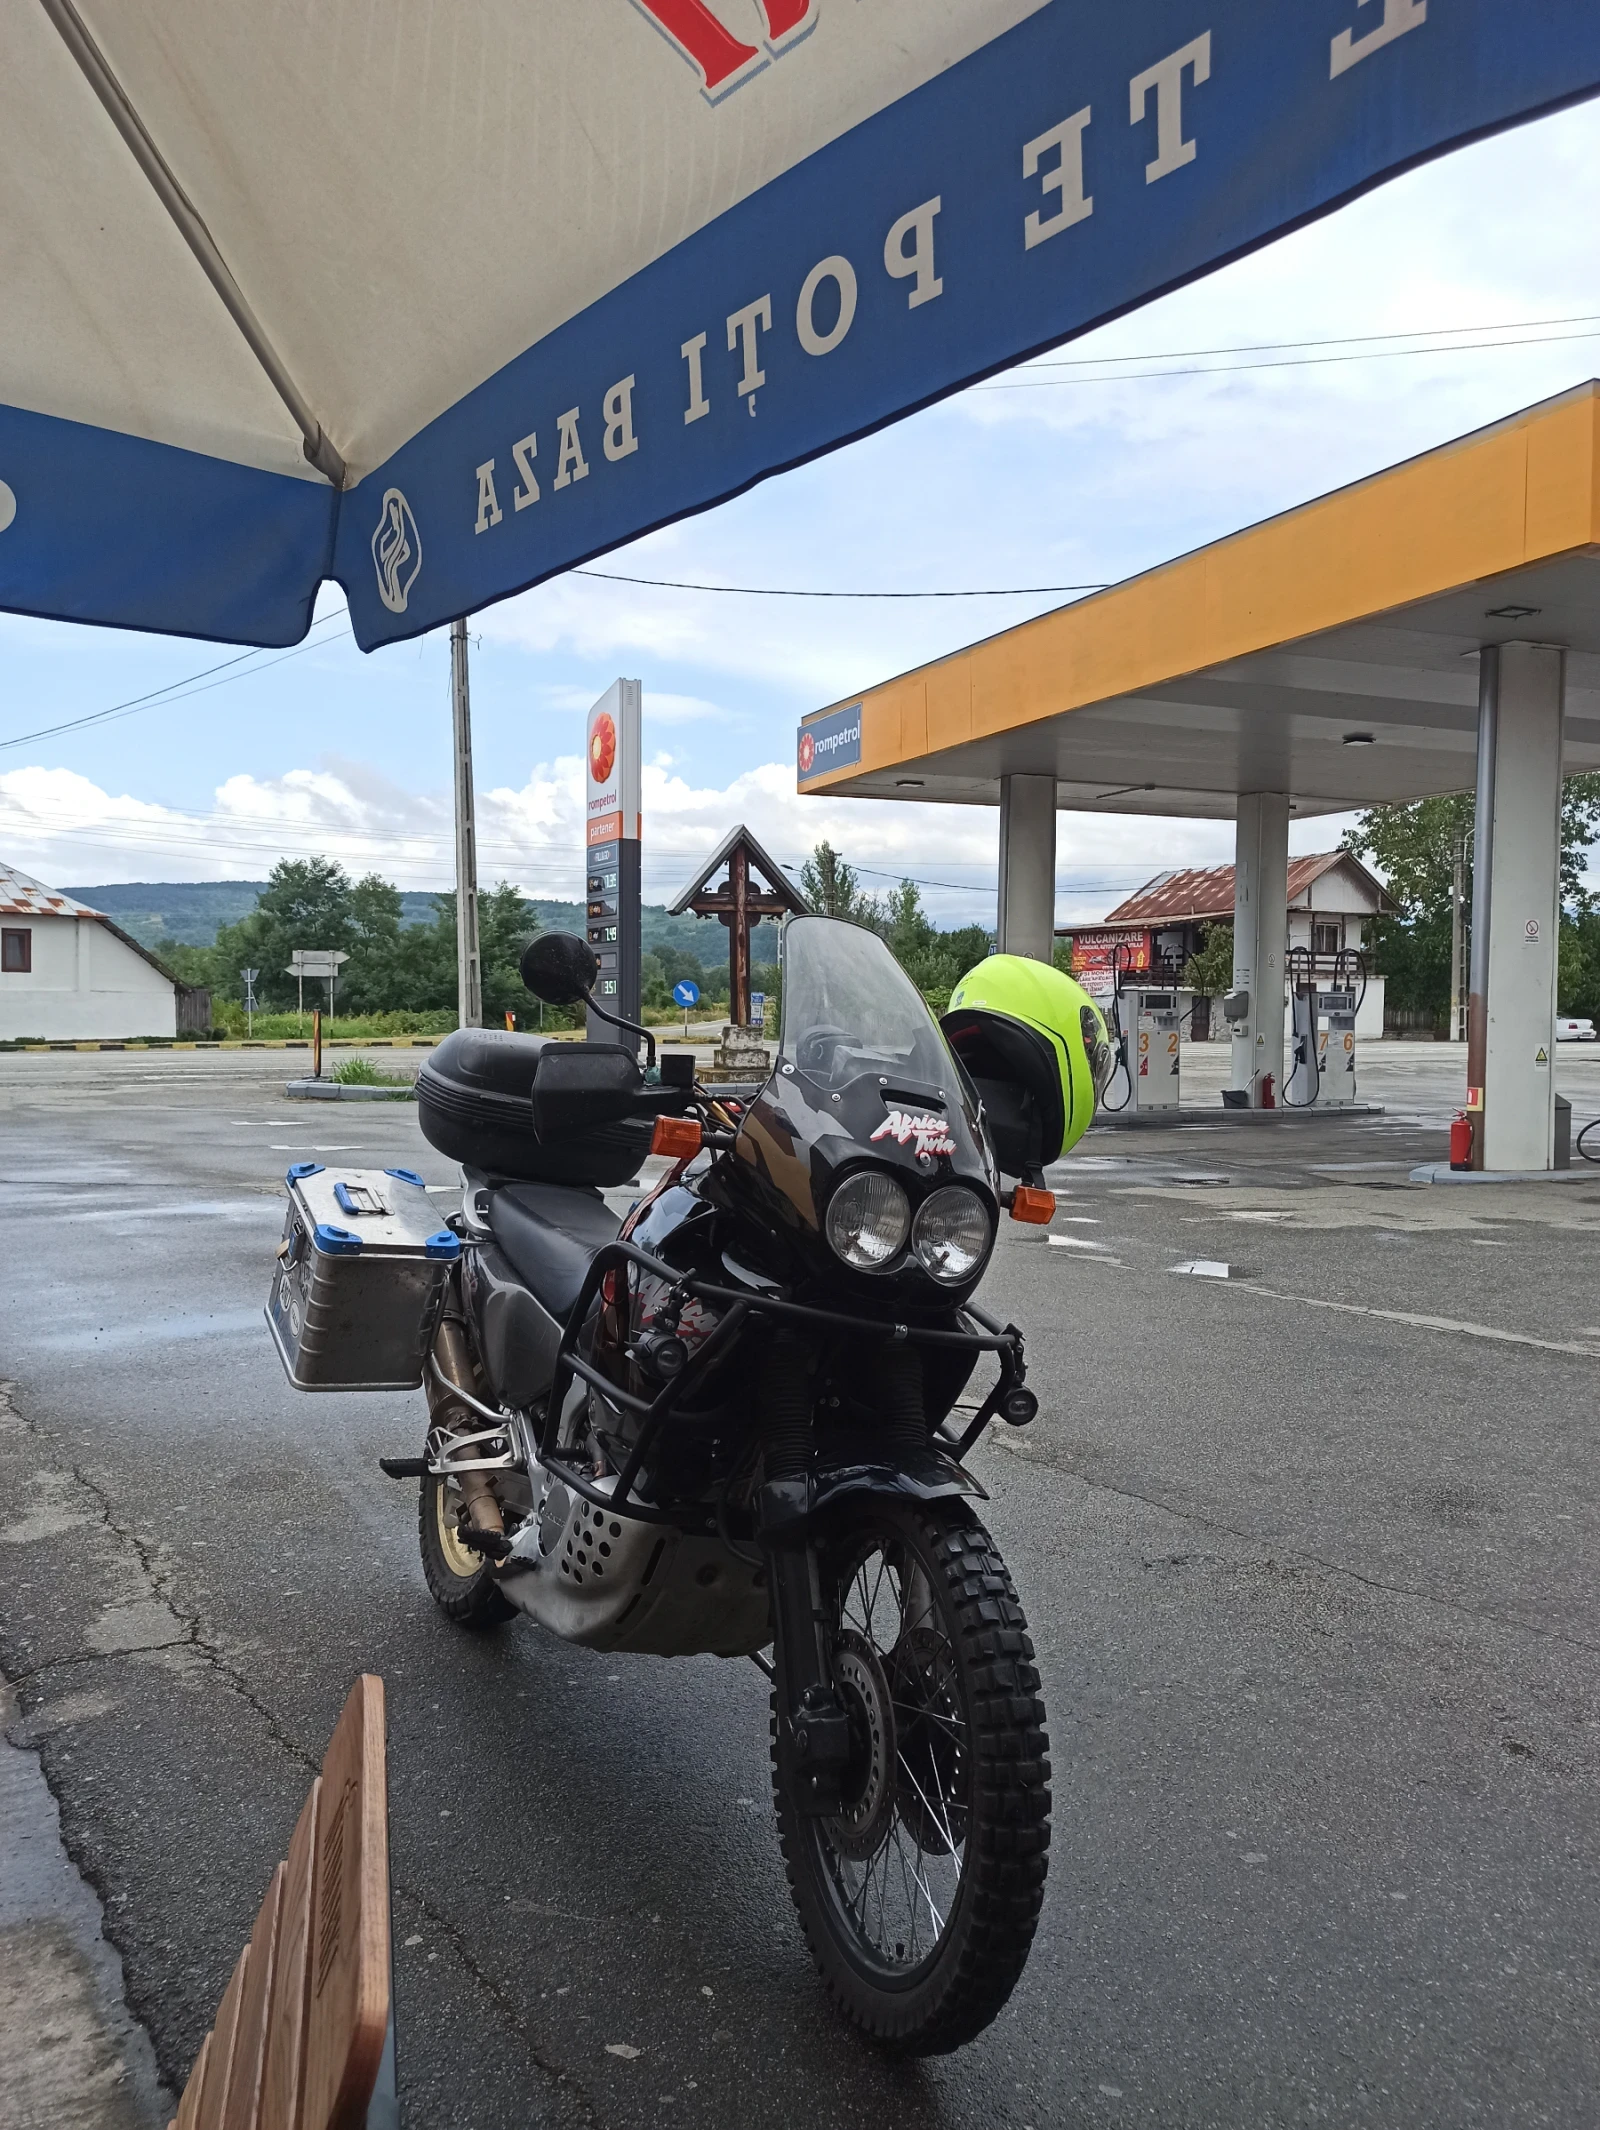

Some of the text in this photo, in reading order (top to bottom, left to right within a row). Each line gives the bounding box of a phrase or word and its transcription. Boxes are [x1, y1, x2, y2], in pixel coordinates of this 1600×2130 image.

[815, 719, 861, 755] rompetrol
[588, 788, 617, 812] rompetrol
[590, 822, 615, 842] partener
[1079, 931, 1144, 945] VULCANIZARE
[1138, 1032, 1150, 1053] 3
[1167, 1032, 1179, 1053] 2
[1319, 1033, 1330, 1051] 7
[1343, 1032, 1354, 1051] 6
